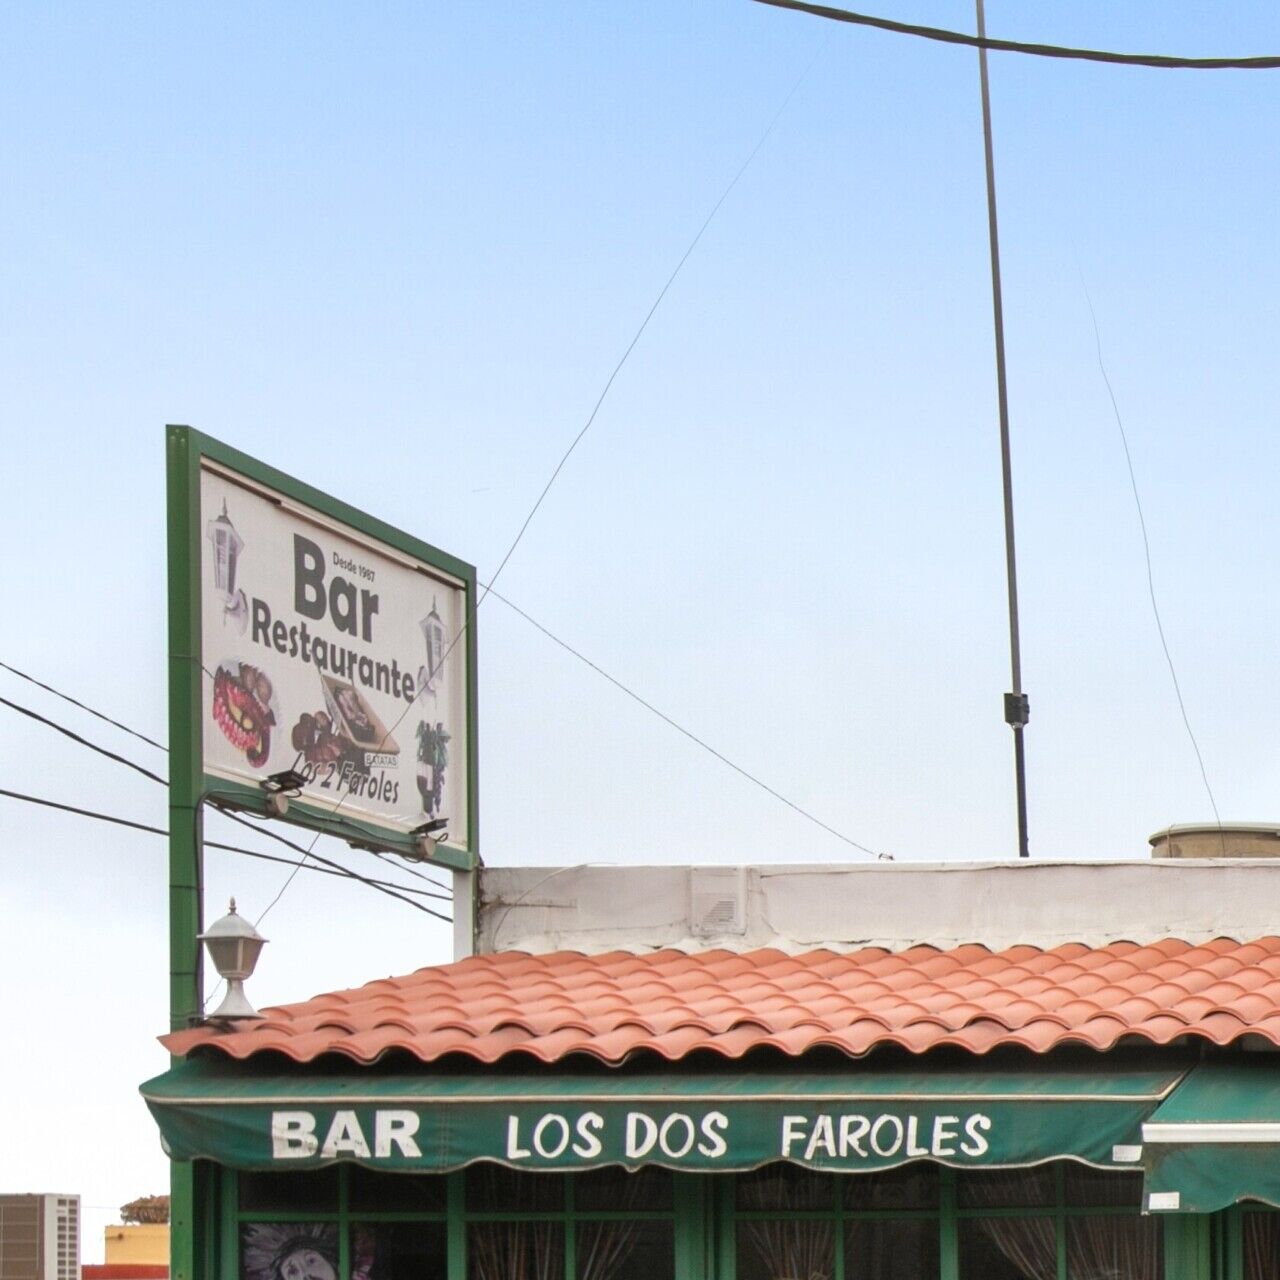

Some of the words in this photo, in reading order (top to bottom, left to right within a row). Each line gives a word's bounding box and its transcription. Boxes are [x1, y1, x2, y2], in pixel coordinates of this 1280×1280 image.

[294, 532, 379, 643] Bar
[333, 551, 358, 576] Desde
[358, 564, 376, 583] 1987
[251, 596, 416, 704] Restaurante
[320, 762, 337, 788] 2
[337, 761, 400, 804] Faroles
[366, 753, 398, 766] BATATAS
[271, 1110, 421, 1159] BAR
[507, 1112, 603, 1158] LOS
[625, 1111, 728, 1158] DOS
[782, 1112, 991, 1159] FAROLES
